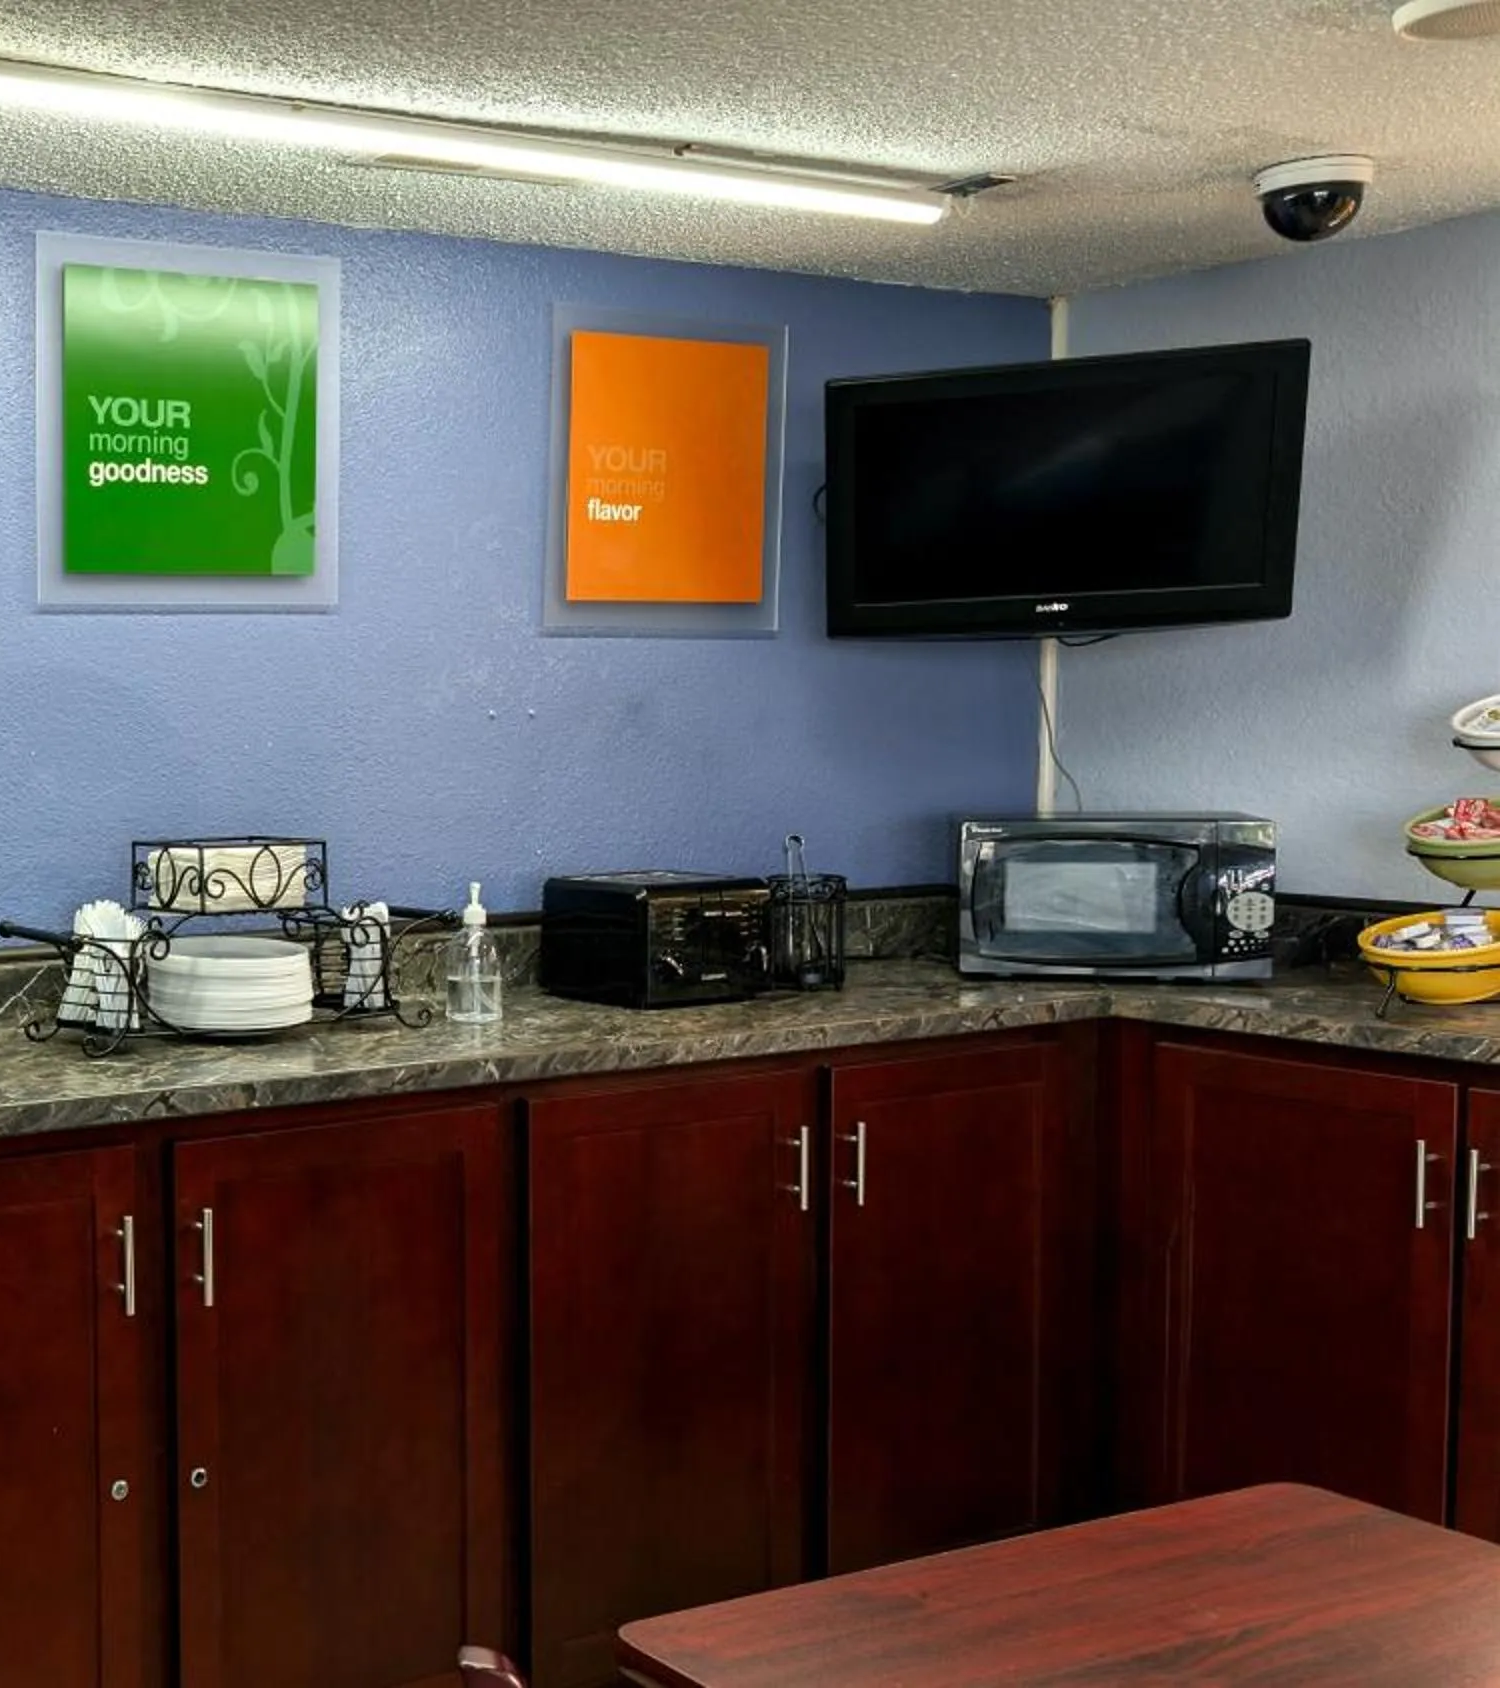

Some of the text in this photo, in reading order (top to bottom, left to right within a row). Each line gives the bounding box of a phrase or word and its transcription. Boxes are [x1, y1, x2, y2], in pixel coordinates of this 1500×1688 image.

[88, 395, 191, 429] YOUR
[89, 430, 189, 460] morning
[586, 444, 667, 474] YOUR
[89, 457, 209, 487] goodness
[586, 477, 665, 503] morning
[588, 497, 643, 522] flavor
